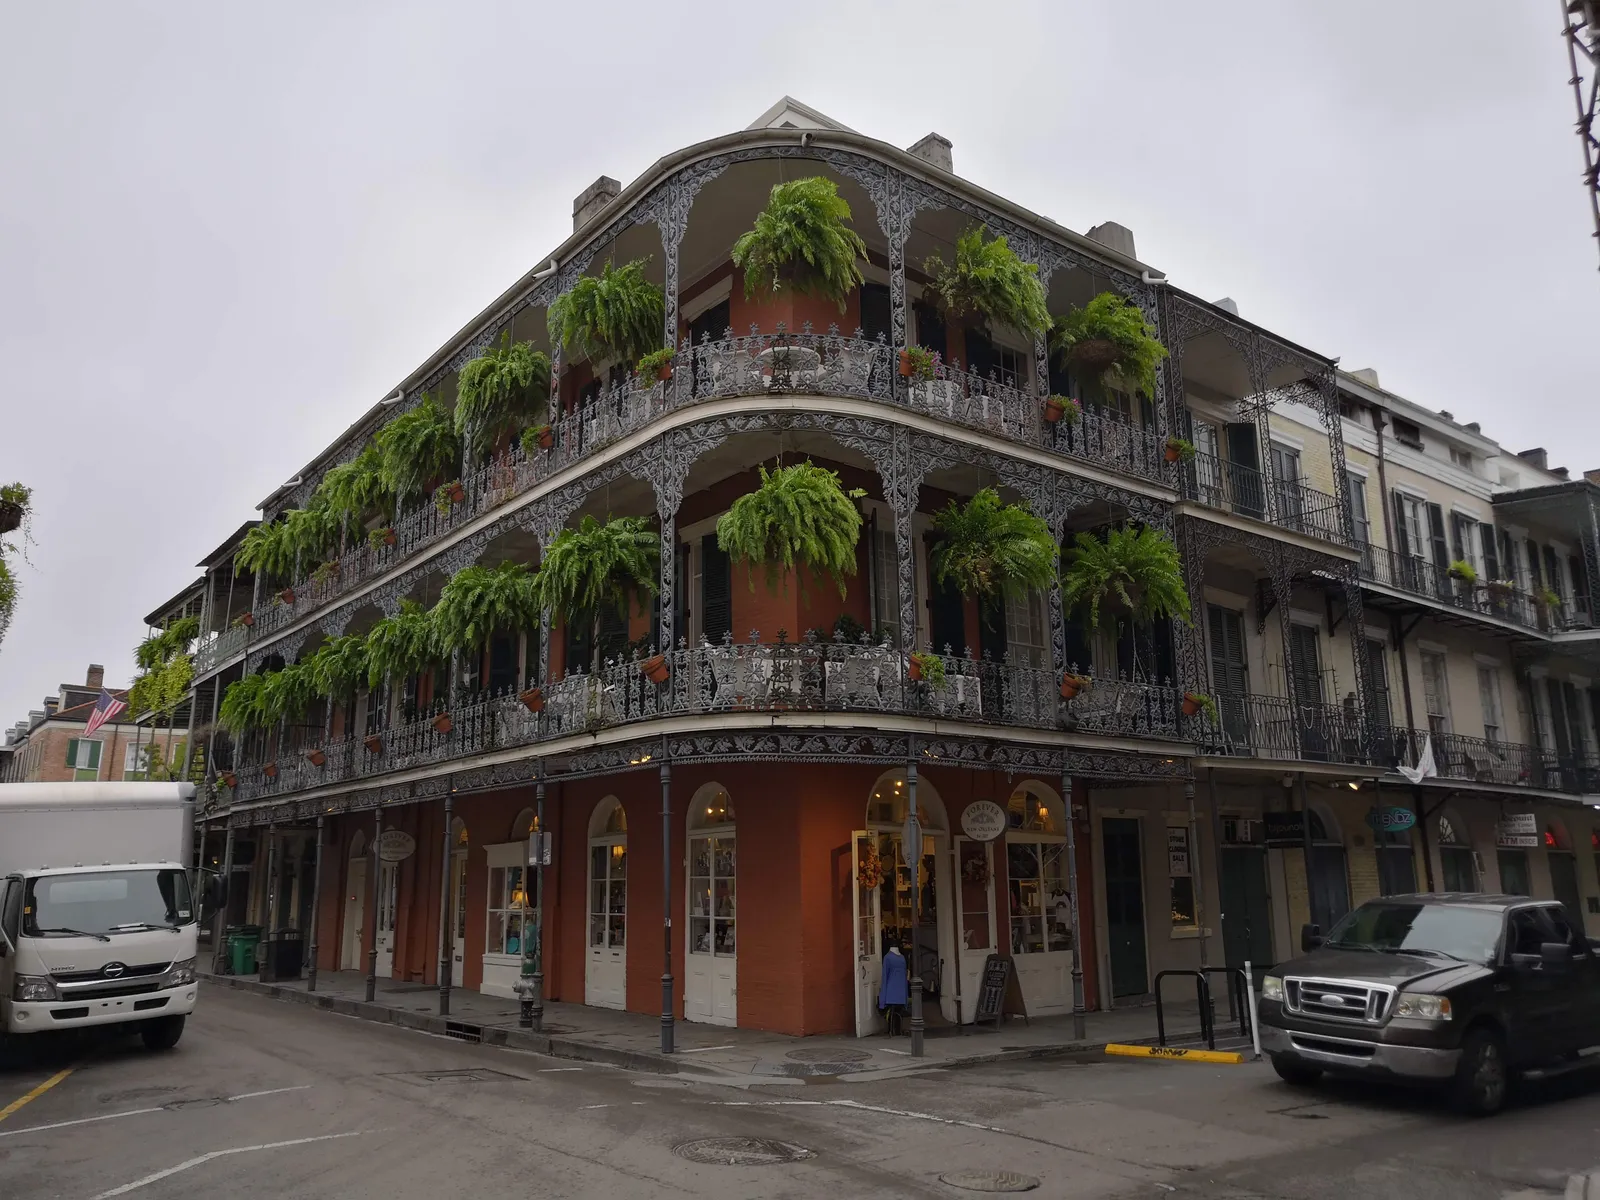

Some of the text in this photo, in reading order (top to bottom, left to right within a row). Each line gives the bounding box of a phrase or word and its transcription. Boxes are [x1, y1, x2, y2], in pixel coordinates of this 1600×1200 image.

[1498, 836, 1518, 845] ATM
[1172, 854, 1185, 862] SALE
[50, 964, 75, 972] HINO
